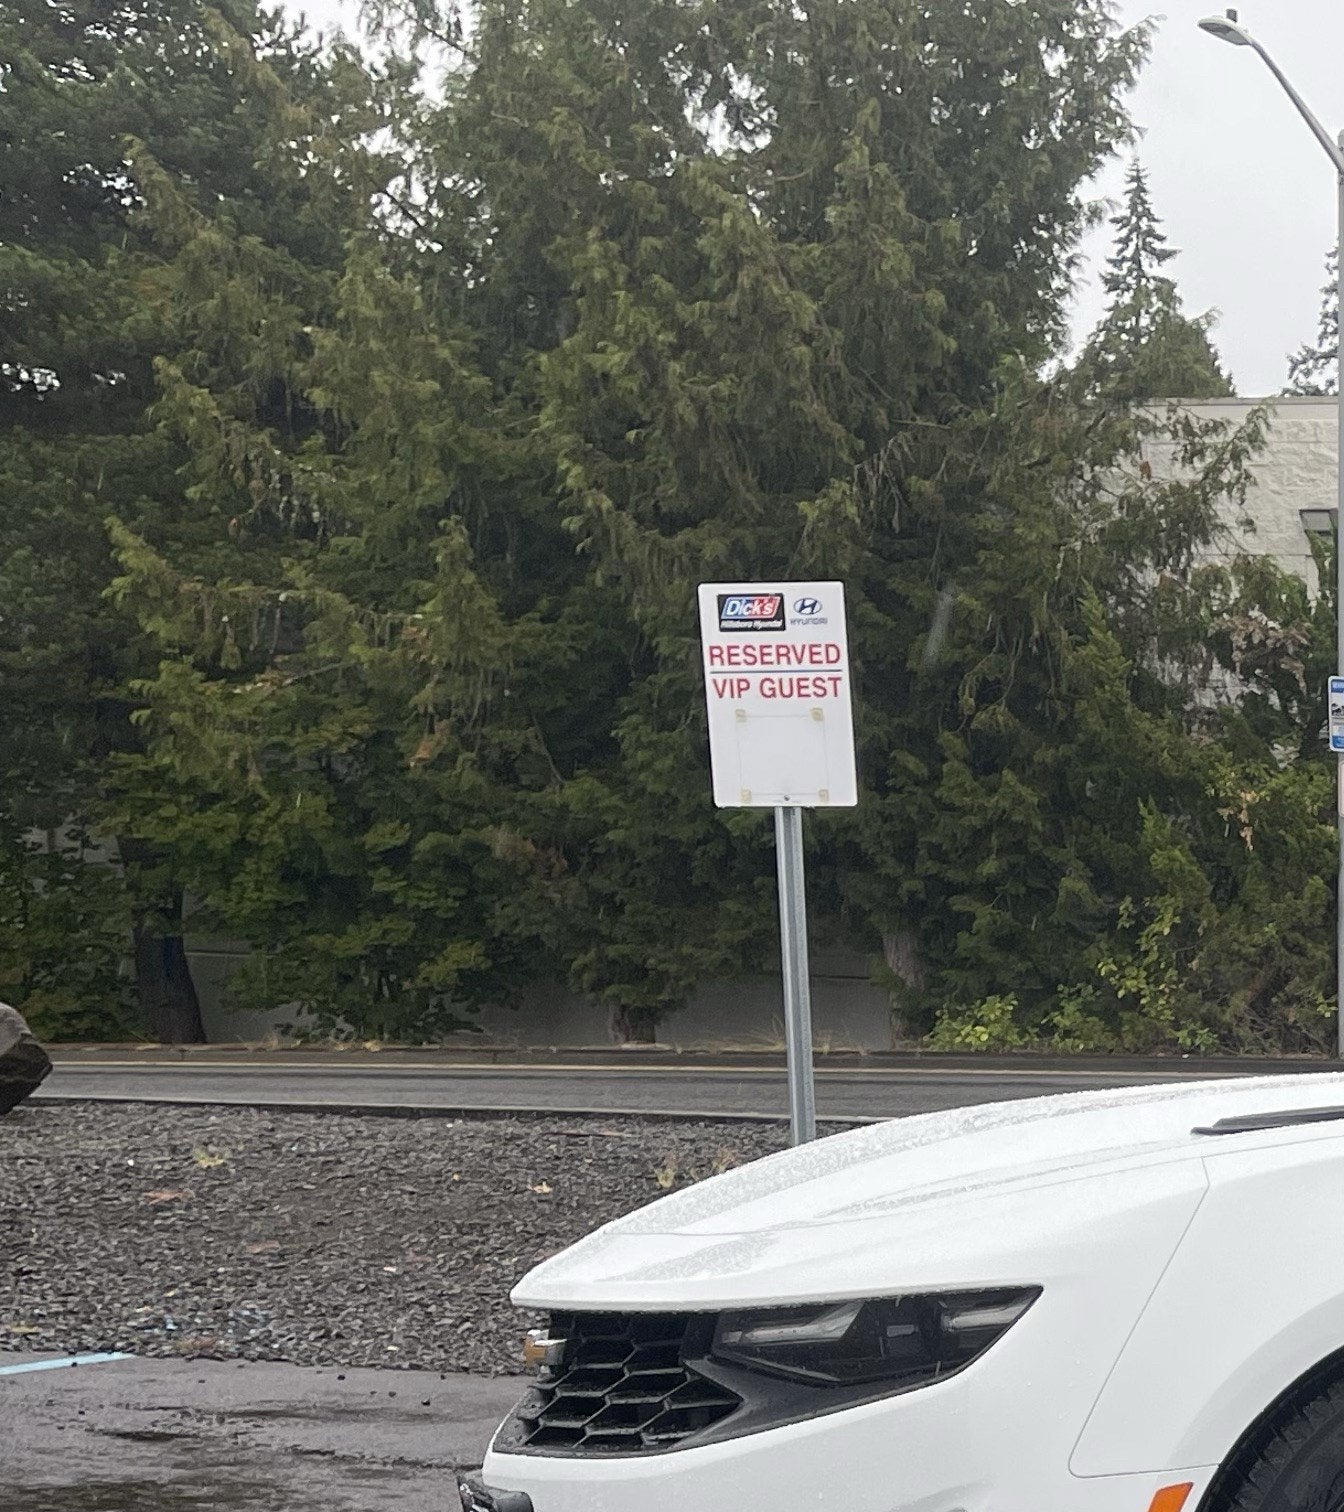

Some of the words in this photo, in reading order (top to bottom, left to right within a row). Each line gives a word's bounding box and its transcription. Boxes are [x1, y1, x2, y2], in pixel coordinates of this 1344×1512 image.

[726, 598, 774, 616] Dick's
[709, 643, 841, 666] RESERVED
[712, 677, 751, 699] VIP
[759, 676, 843, 699] GUEST
